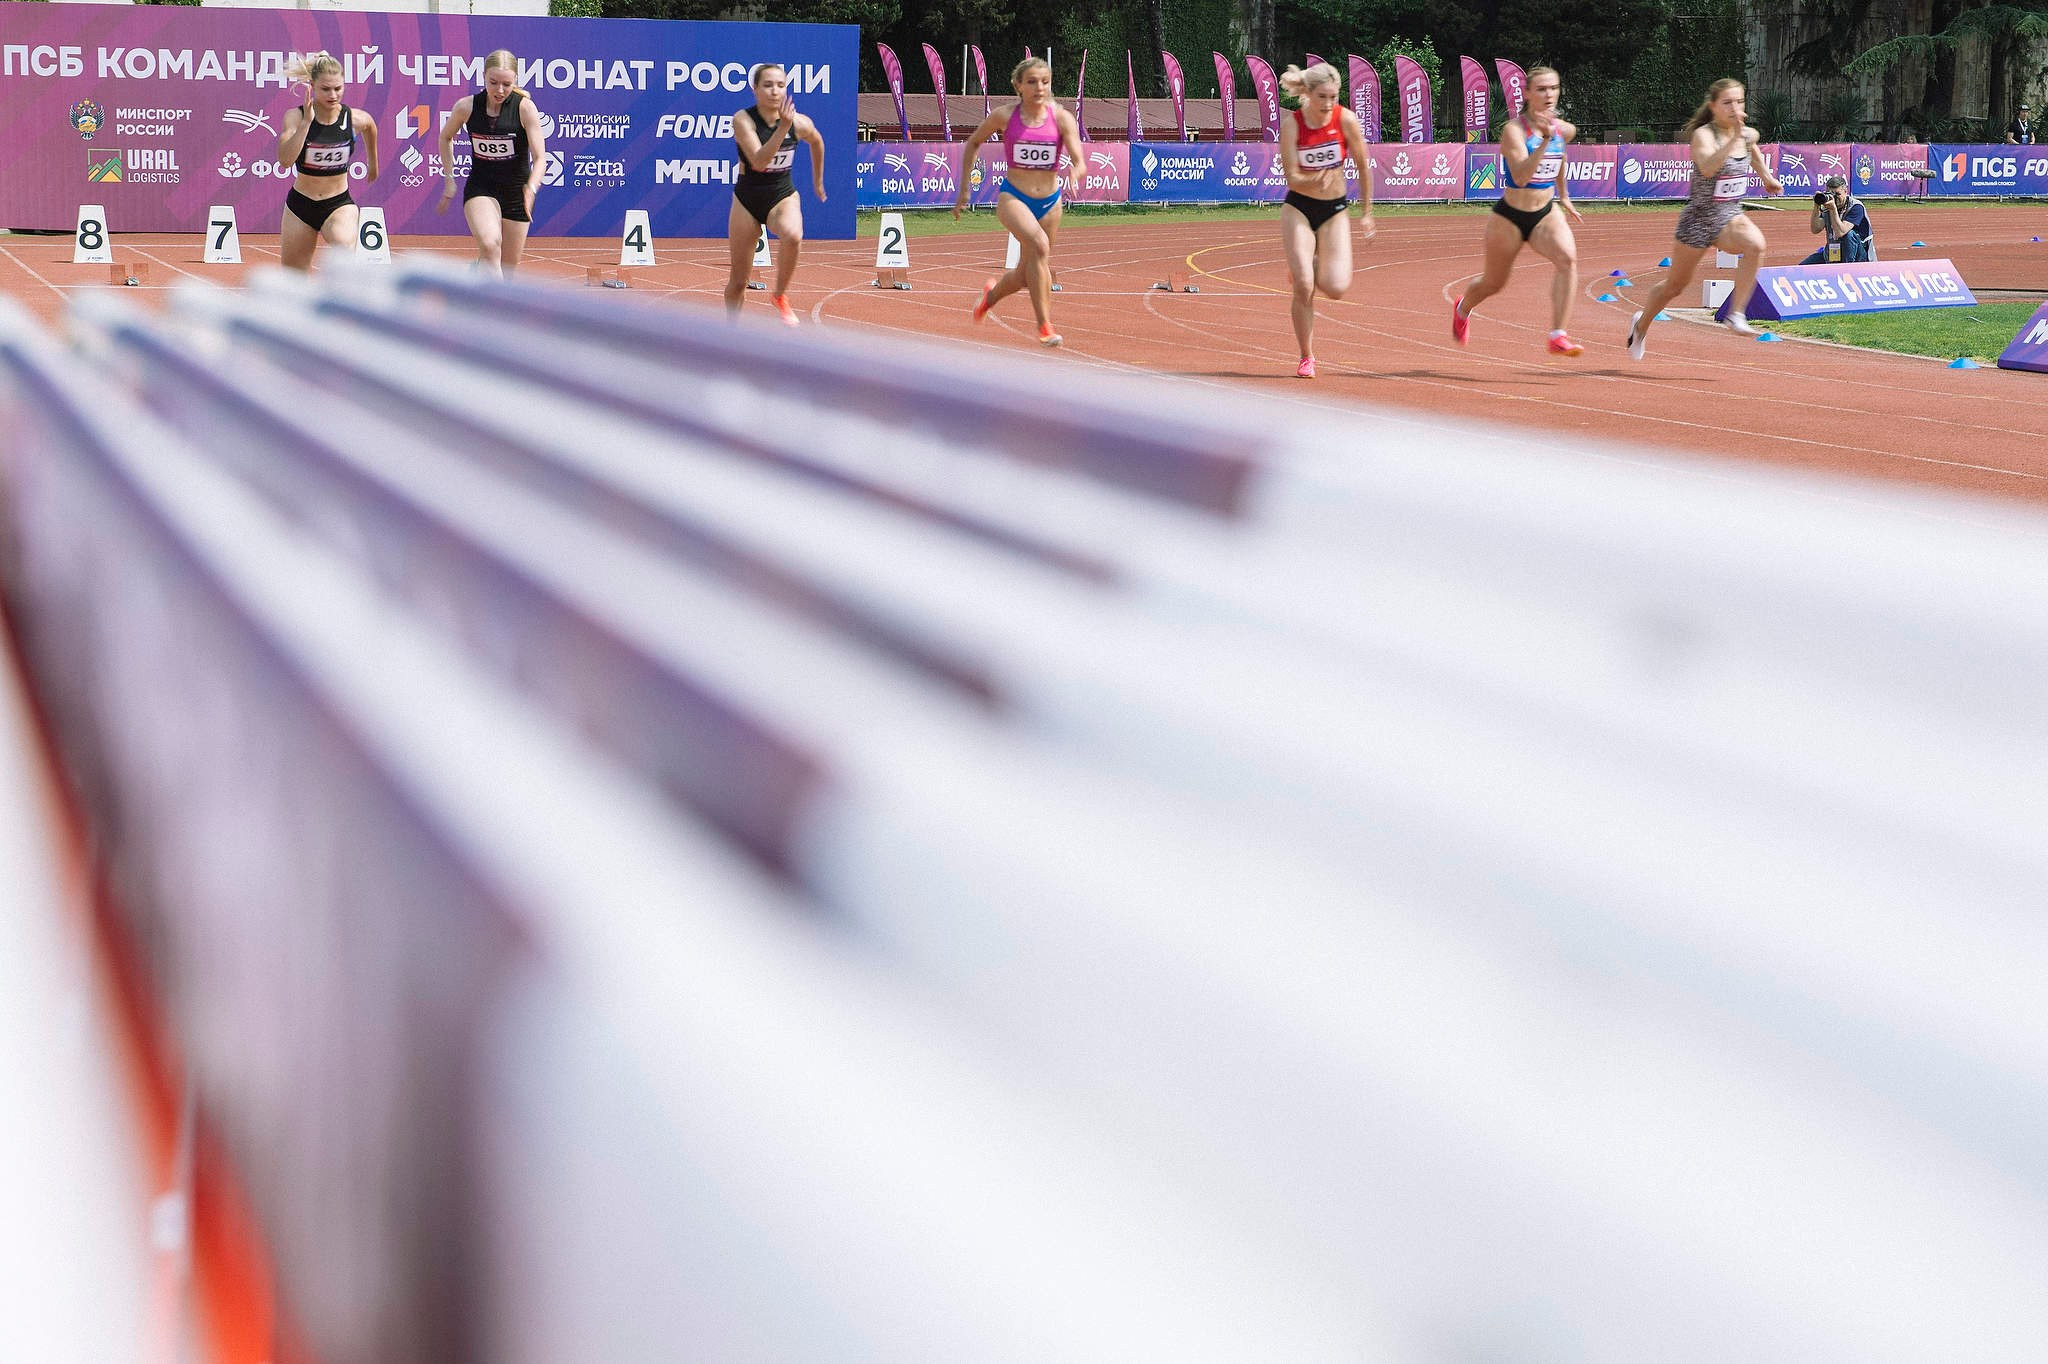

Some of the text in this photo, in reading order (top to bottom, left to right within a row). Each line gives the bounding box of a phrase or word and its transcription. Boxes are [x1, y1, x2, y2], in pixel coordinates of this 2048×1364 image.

[3, 44, 84, 77] ПСБ
[98, 45, 384, 88] КОМАНДЙ
[398, 54, 654, 91] ЧЕМИОНАТ
[116, 108, 192, 121] МИНСПОРТ
[559, 114, 630, 124] БАЛТИЙСКИЙ
[116, 124, 174, 136] РОССИИ
[557, 124, 630, 139] ЛИЗИНГ
[655, 115, 734, 139] FONB
[478, 142, 508, 153] 083
[1020, 148, 1050, 161] 306
[127, 149, 180, 170] URAL
[313, 151, 343, 162] 543
[774, 155, 787, 165] 17
[1160, 157, 1215, 170] КОМАНДА
[1305, 150, 1336, 163] 096
[574, 160, 626, 177] zetta
[1563, 161, 1615, 181] NBET
[1880, 160, 1926, 170] МИНСПОРТ
[1972, 157, 2017, 178] ПСБ
[2023, 158, 2048, 177] FO
[128, 172, 180, 184] LOGISTICS
[1160, 169, 1204, 180] РОССИИ
[1224, 177, 1258, 186] ФОСАГРО
[1384, 177, 1419, 186] ФОСАГРО
[1424, 177, 1456, 185] ФОСАГРО
[1642, 169, 1693, 182] ЛИЗИНГ
[1779, 174, 1811, 187] ВФЛА
[882, 178, 915, 194] ВФЛА
[922, 177, 955, 192] ВФЛА
[1085, 175, 1120, 190] ВФЛА
[78, 219, 103, 250] 8
[211, 220, 233, 250] 7
[360, 220, 383, 251] 6
[625, 224, 647, 252] 4
[882, 226, 902, 255] 2
[1793, 279, 1838, 301] ПСБ
[1858, 275, 1900, 297] ПСБ
[1919, 272, 1959, 294] ПСБ
